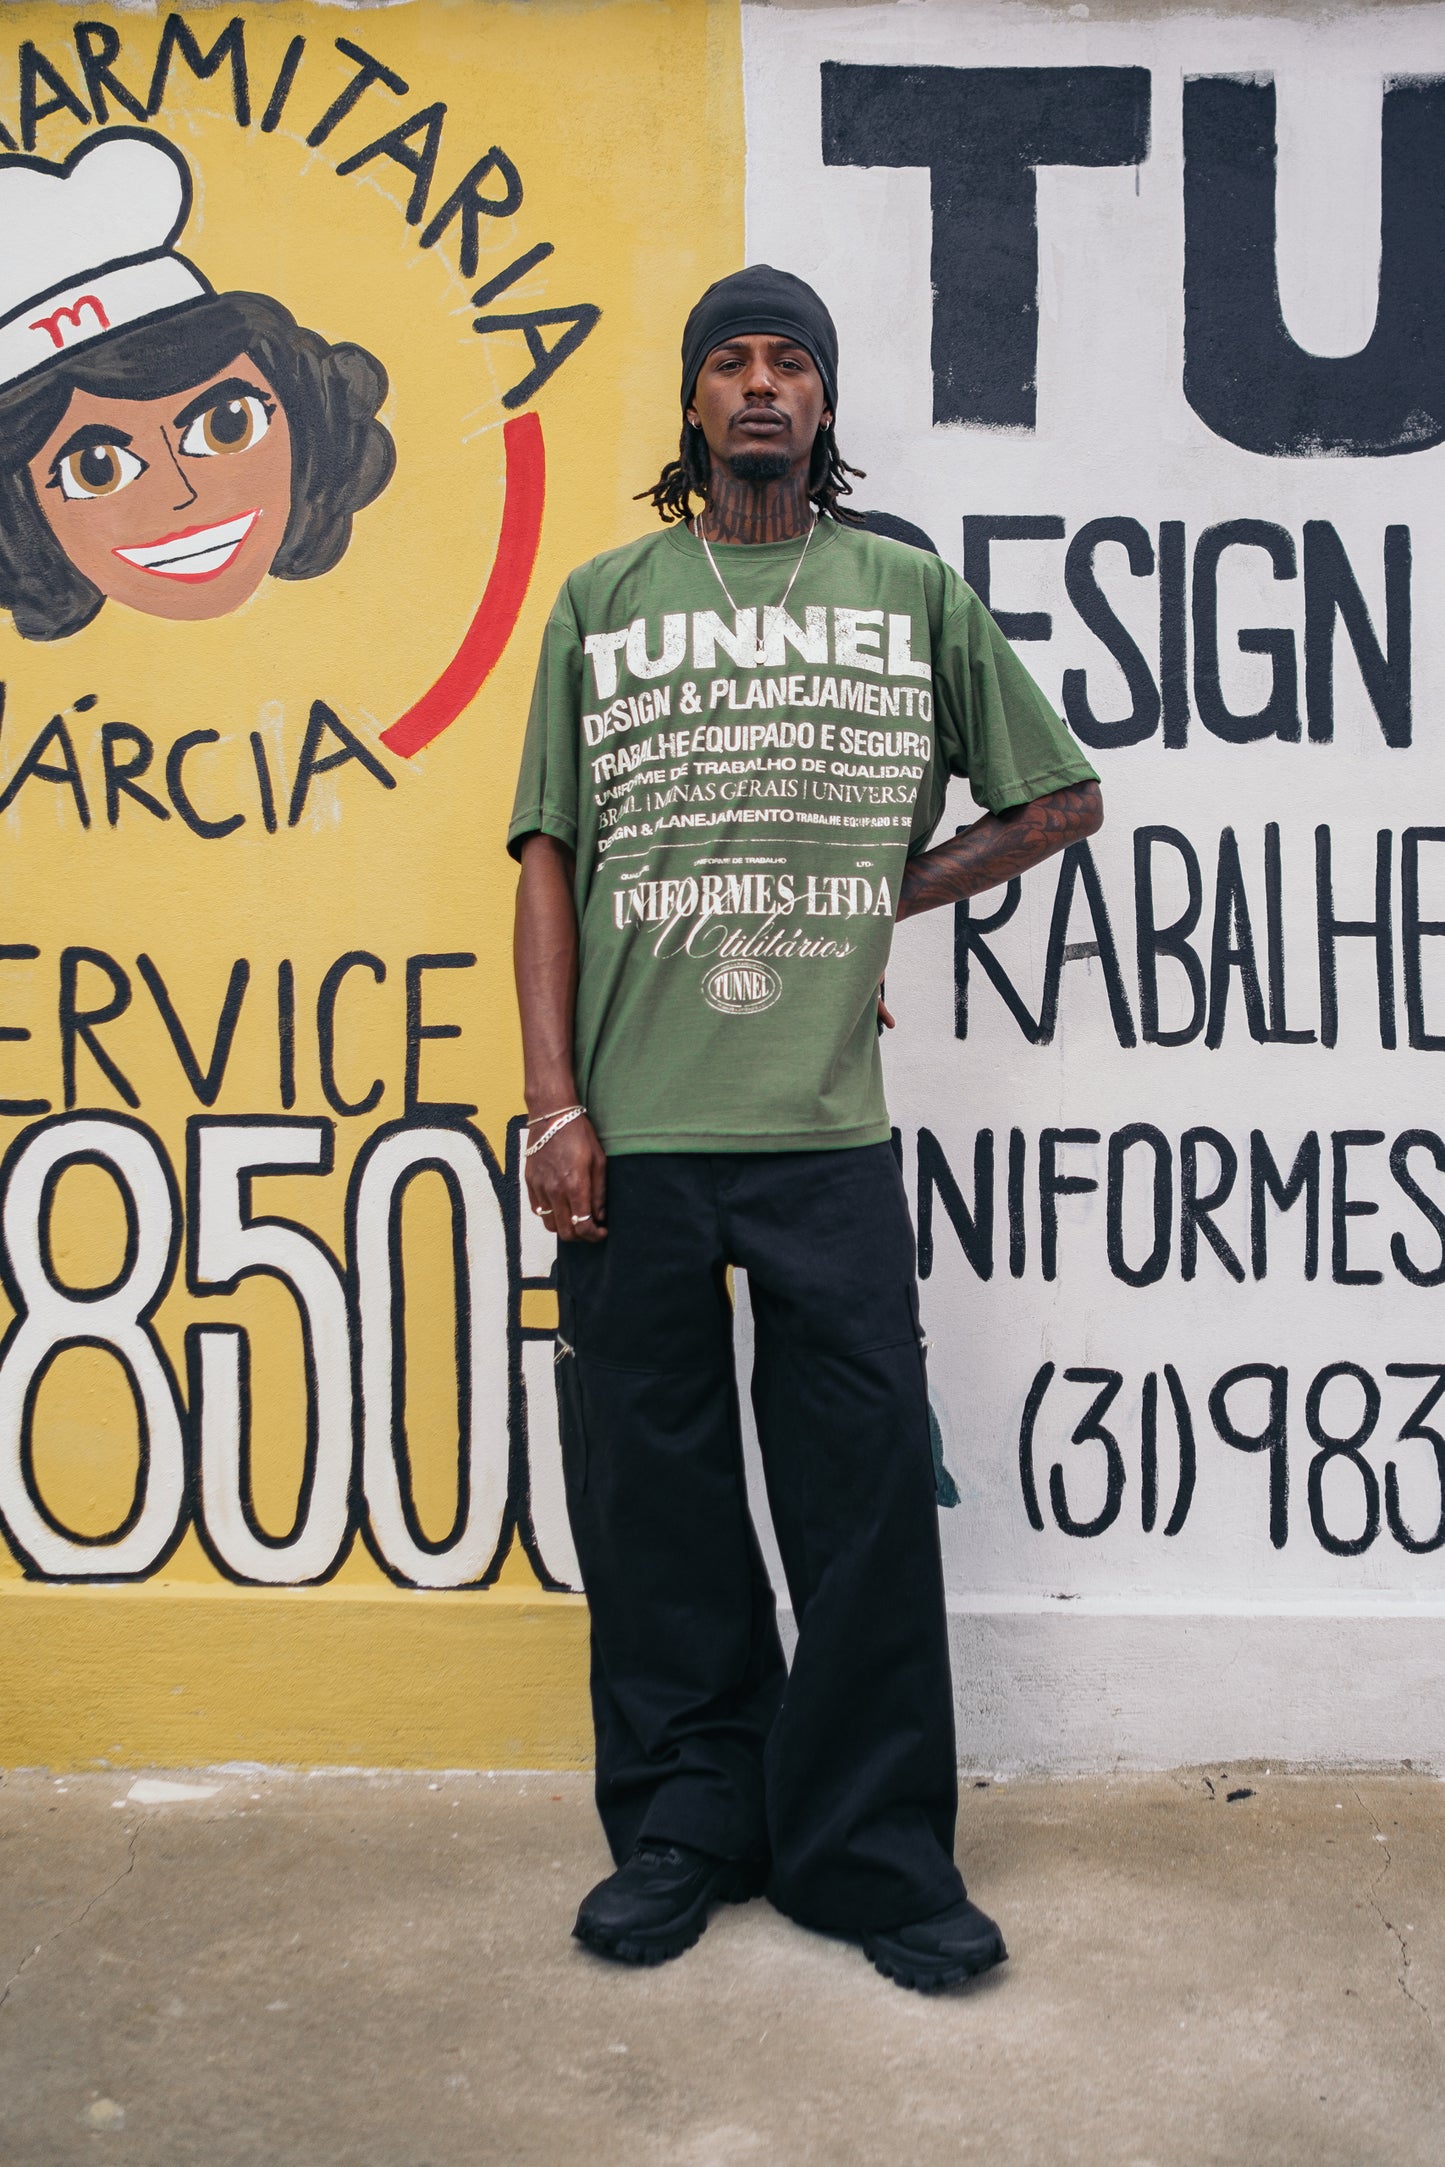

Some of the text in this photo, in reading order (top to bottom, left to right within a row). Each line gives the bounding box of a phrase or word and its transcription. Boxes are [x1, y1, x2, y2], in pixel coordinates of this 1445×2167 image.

[0, 15, 603, 409] ARMITARIA
[820, 59, 1445, 459] TU
[584, 606, 931, 700] TUNNEL
[583, 675, 932, 747] DESIGN & PLANEJAMENTO
[691, 722, 814, 754] EQUIPADO
[821, 724, 836, 751] E
[840, 727, 931, 762] SEGURO
[0, 682, 397, 839] ÁRCIA
[671, 763, 689, 780] DE
[693, 757, 797, 775] TRABALHO
[801, 758, 827, 773] DE
[721, 779, 799, 801] GERAIS
[640, 823, 654, 836] &
[796, 812, 841, 827] TRABALHE
[649, 893, 858, 960] Utilitários
[806, 876, 892, 916] LTDA
[878, 822, 1445, 1051] RABALHE
[714, 970, 770, 1001] TUNNEL
[891, 1126, 1445, 1287] NIFORMES
